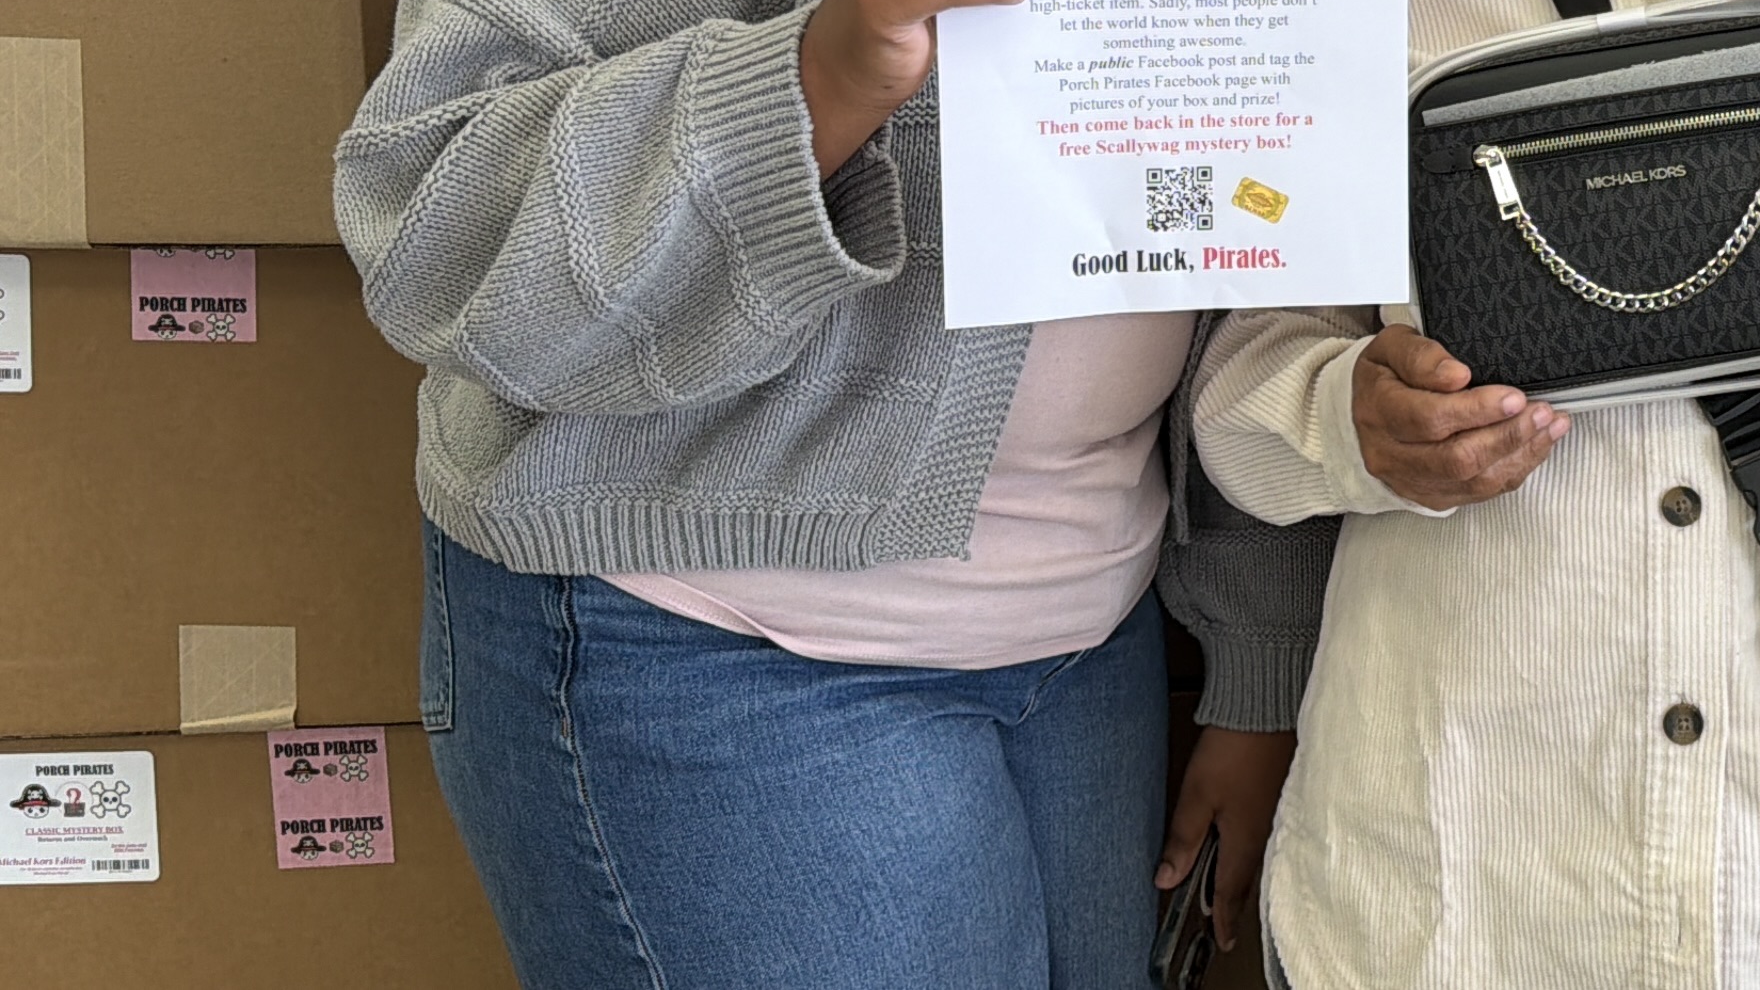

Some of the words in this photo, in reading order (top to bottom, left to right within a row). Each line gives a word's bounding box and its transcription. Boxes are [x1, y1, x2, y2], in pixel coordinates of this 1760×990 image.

[1060, 18, 1077, 31] let
[1082, 17, 1102, 30] the
[1106, 16, 1147, 29] world
[1151, 15, 1189, 28] know
[1194, 15, 1230, 27] when
[1235, 14, 1264, 29] they
[1268, 15, 1288, 29] get
[1103, 35, 1175, 50] something
[1179, 35, 1247, 47] awesome.
[1034, 58, 1073, 72] Make
[1077, 63, 1085, 71] a
[1088, 56, 1134, 73] public
[1138, 54, 1204, 68] Facebook
[1208, 55, 1236, 69] post
[1241, 53, 1265, 65] and
[1270, 54, 1290, 68] tag
[1295, 52, 1315, 65] the
[1059, 77, 1099, 91] Porch
[1104, 76, 1150, 90] Pirates
[1155, 74, 1220, 88] Facebook
[1225, 75, 1257, 89] page
[1261, 72, 1291, 85] with
[1070, 98, 1124, 114] pictures
[1128, 95, 1145, 108] of
[1147, 97, 1179, 111] your
[1183, 94, 1208, 107] box
[1212, 93, 1237, 106] and
[1241, 91, 1280, 108] prize!
[1037, 120, 1079, 135] Then
[1085, 119, 1128, 132] come
[1134, 115, 1173, 130] back
[1179, 114, 1194, 128] in
[1200, 114, 1225, 128] the
[1230, 113, 1270, 127] store
[1276, 112, 1300, 126] for
[1304, 115, 1313, 126] a
[1059, 142, 1091, 157] free
[1095, 138, 1180, 156] Scallywag
[1185, 136, 1250, 154] mystery
[1256, 134, 1292, 149] box!
[1586, 170, 1648, 191] MICHAEL
[1649, 164, 1687, 181] KORS
[1072, 250, 1129, 277] Good
[1136, 248, 1195, 273] Luck,
[1203, 245, 1287, 270] Pirates.
[139, 296, 187, 312] PORCH
[191, 297, 247, 313] PIRATES
[274, 742, 320, 758] PORCH
[323, 739, 378, 756] PIRATES
[36, 765, 70, 776] PORCH
[73, 764, 114, 776] PIRATES
[281, 819, 326, 835] PORCH
[330, 816, 384, 833] PIRATES
